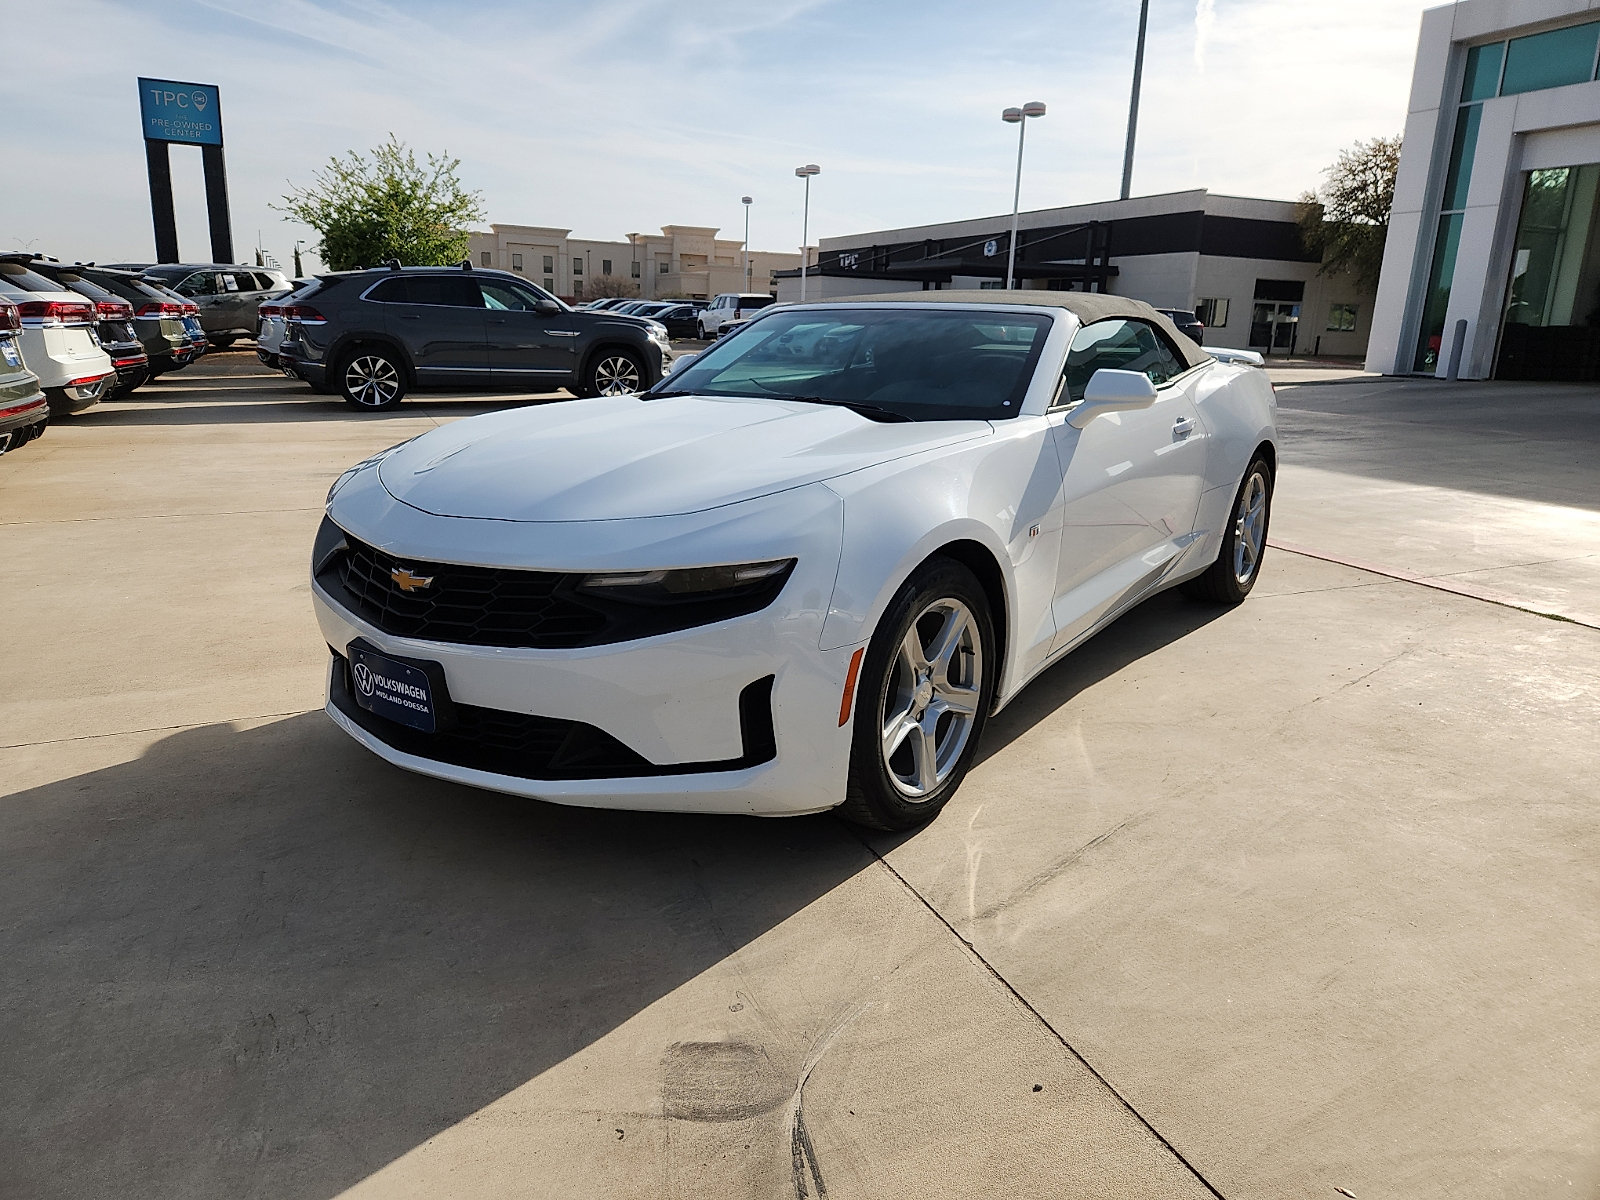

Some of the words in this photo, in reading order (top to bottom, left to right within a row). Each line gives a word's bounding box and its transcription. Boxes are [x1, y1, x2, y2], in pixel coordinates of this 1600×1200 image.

[150, 89, 189, 108] TPC
[151, 118, 212, 131] PRE-OWNED
[164, 128, 201, 138] CENTER
[373, 672, 427, 701] VOLKSWAGEN
[375, 689, 402, 705] MIDLAND
[402, 699, 430, 714] ODESSA
